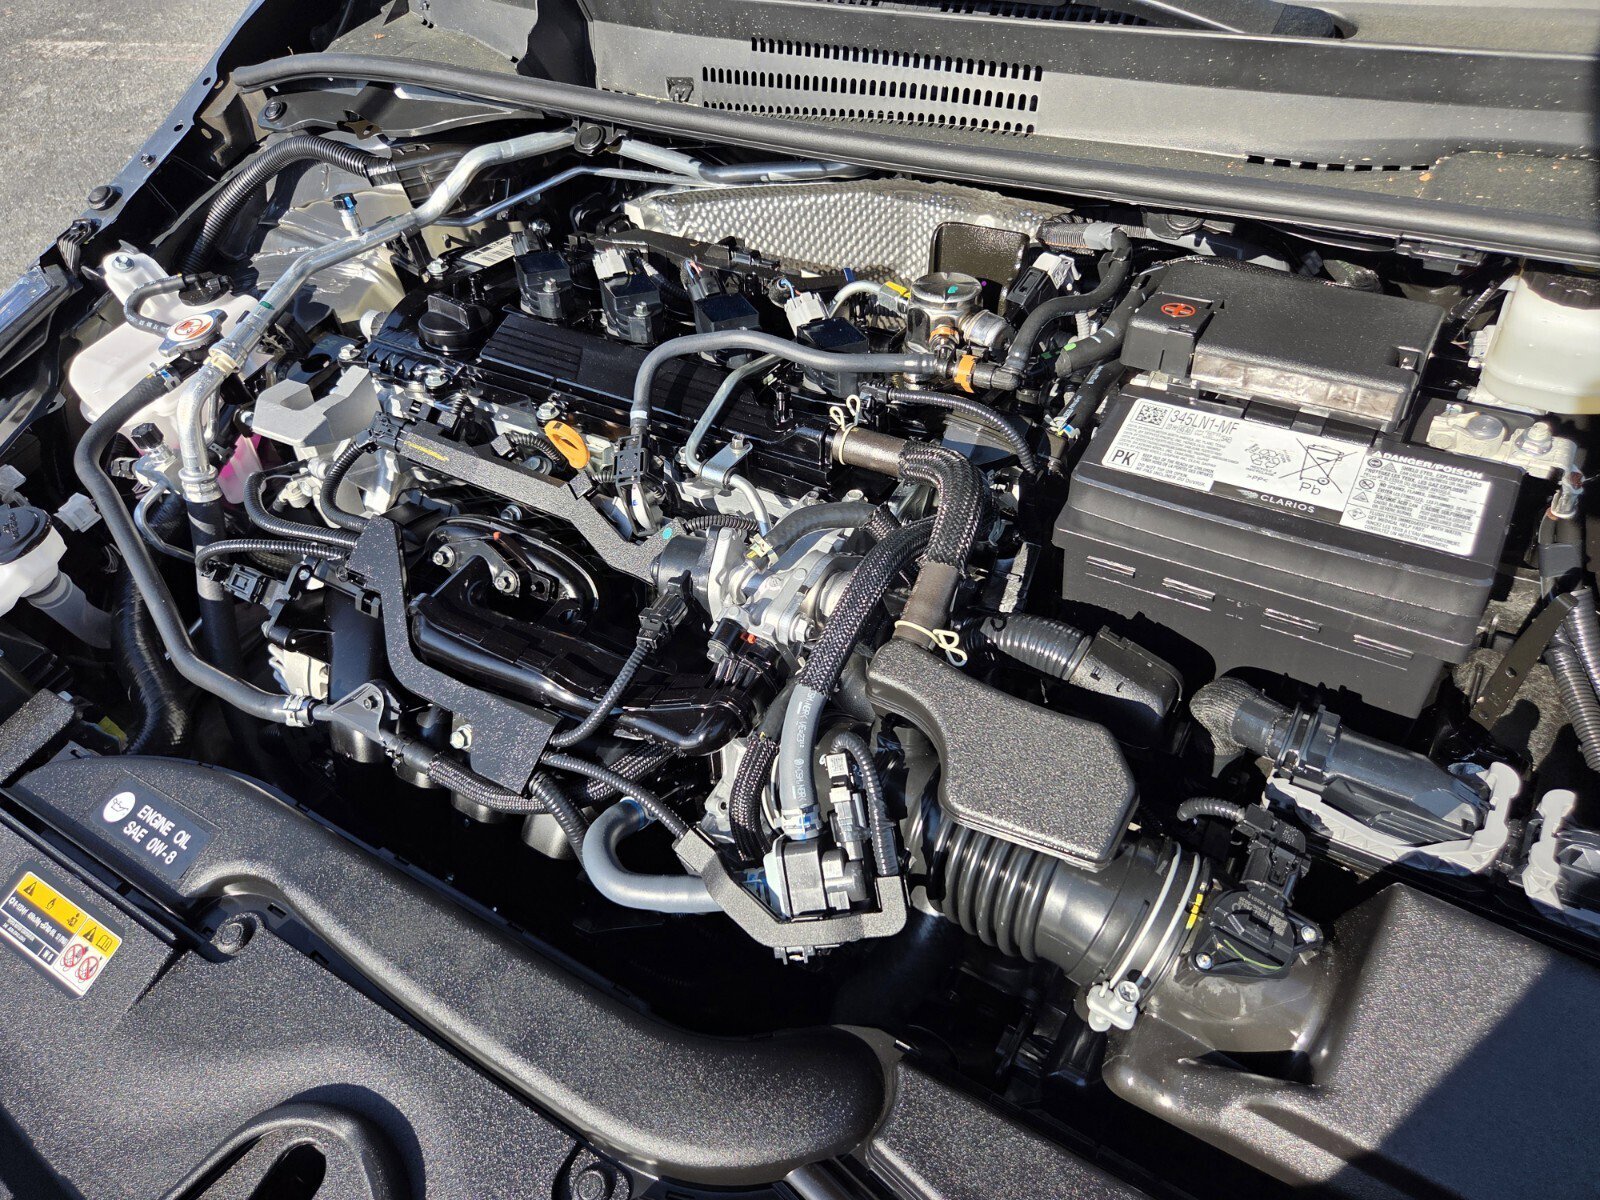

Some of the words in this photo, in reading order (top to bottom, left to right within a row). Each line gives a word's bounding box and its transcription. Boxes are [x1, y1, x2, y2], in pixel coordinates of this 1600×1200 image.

[1170, 410, 1239, 434] 345LN1-MF
[1111, 449, 1135, 465] PK
[1382, 453, 1483, 479] DANGER/POISON
[1299, 481, 1322, 495] Pb
[1260, 494, 1315, 513] CLARIOS
[137, 805, 175, 836] ENGINE
[173, 830, 192, 850] OIL
[123, 821, 148, 843] SAE
[147, 837, 177, 865] 0W-8
